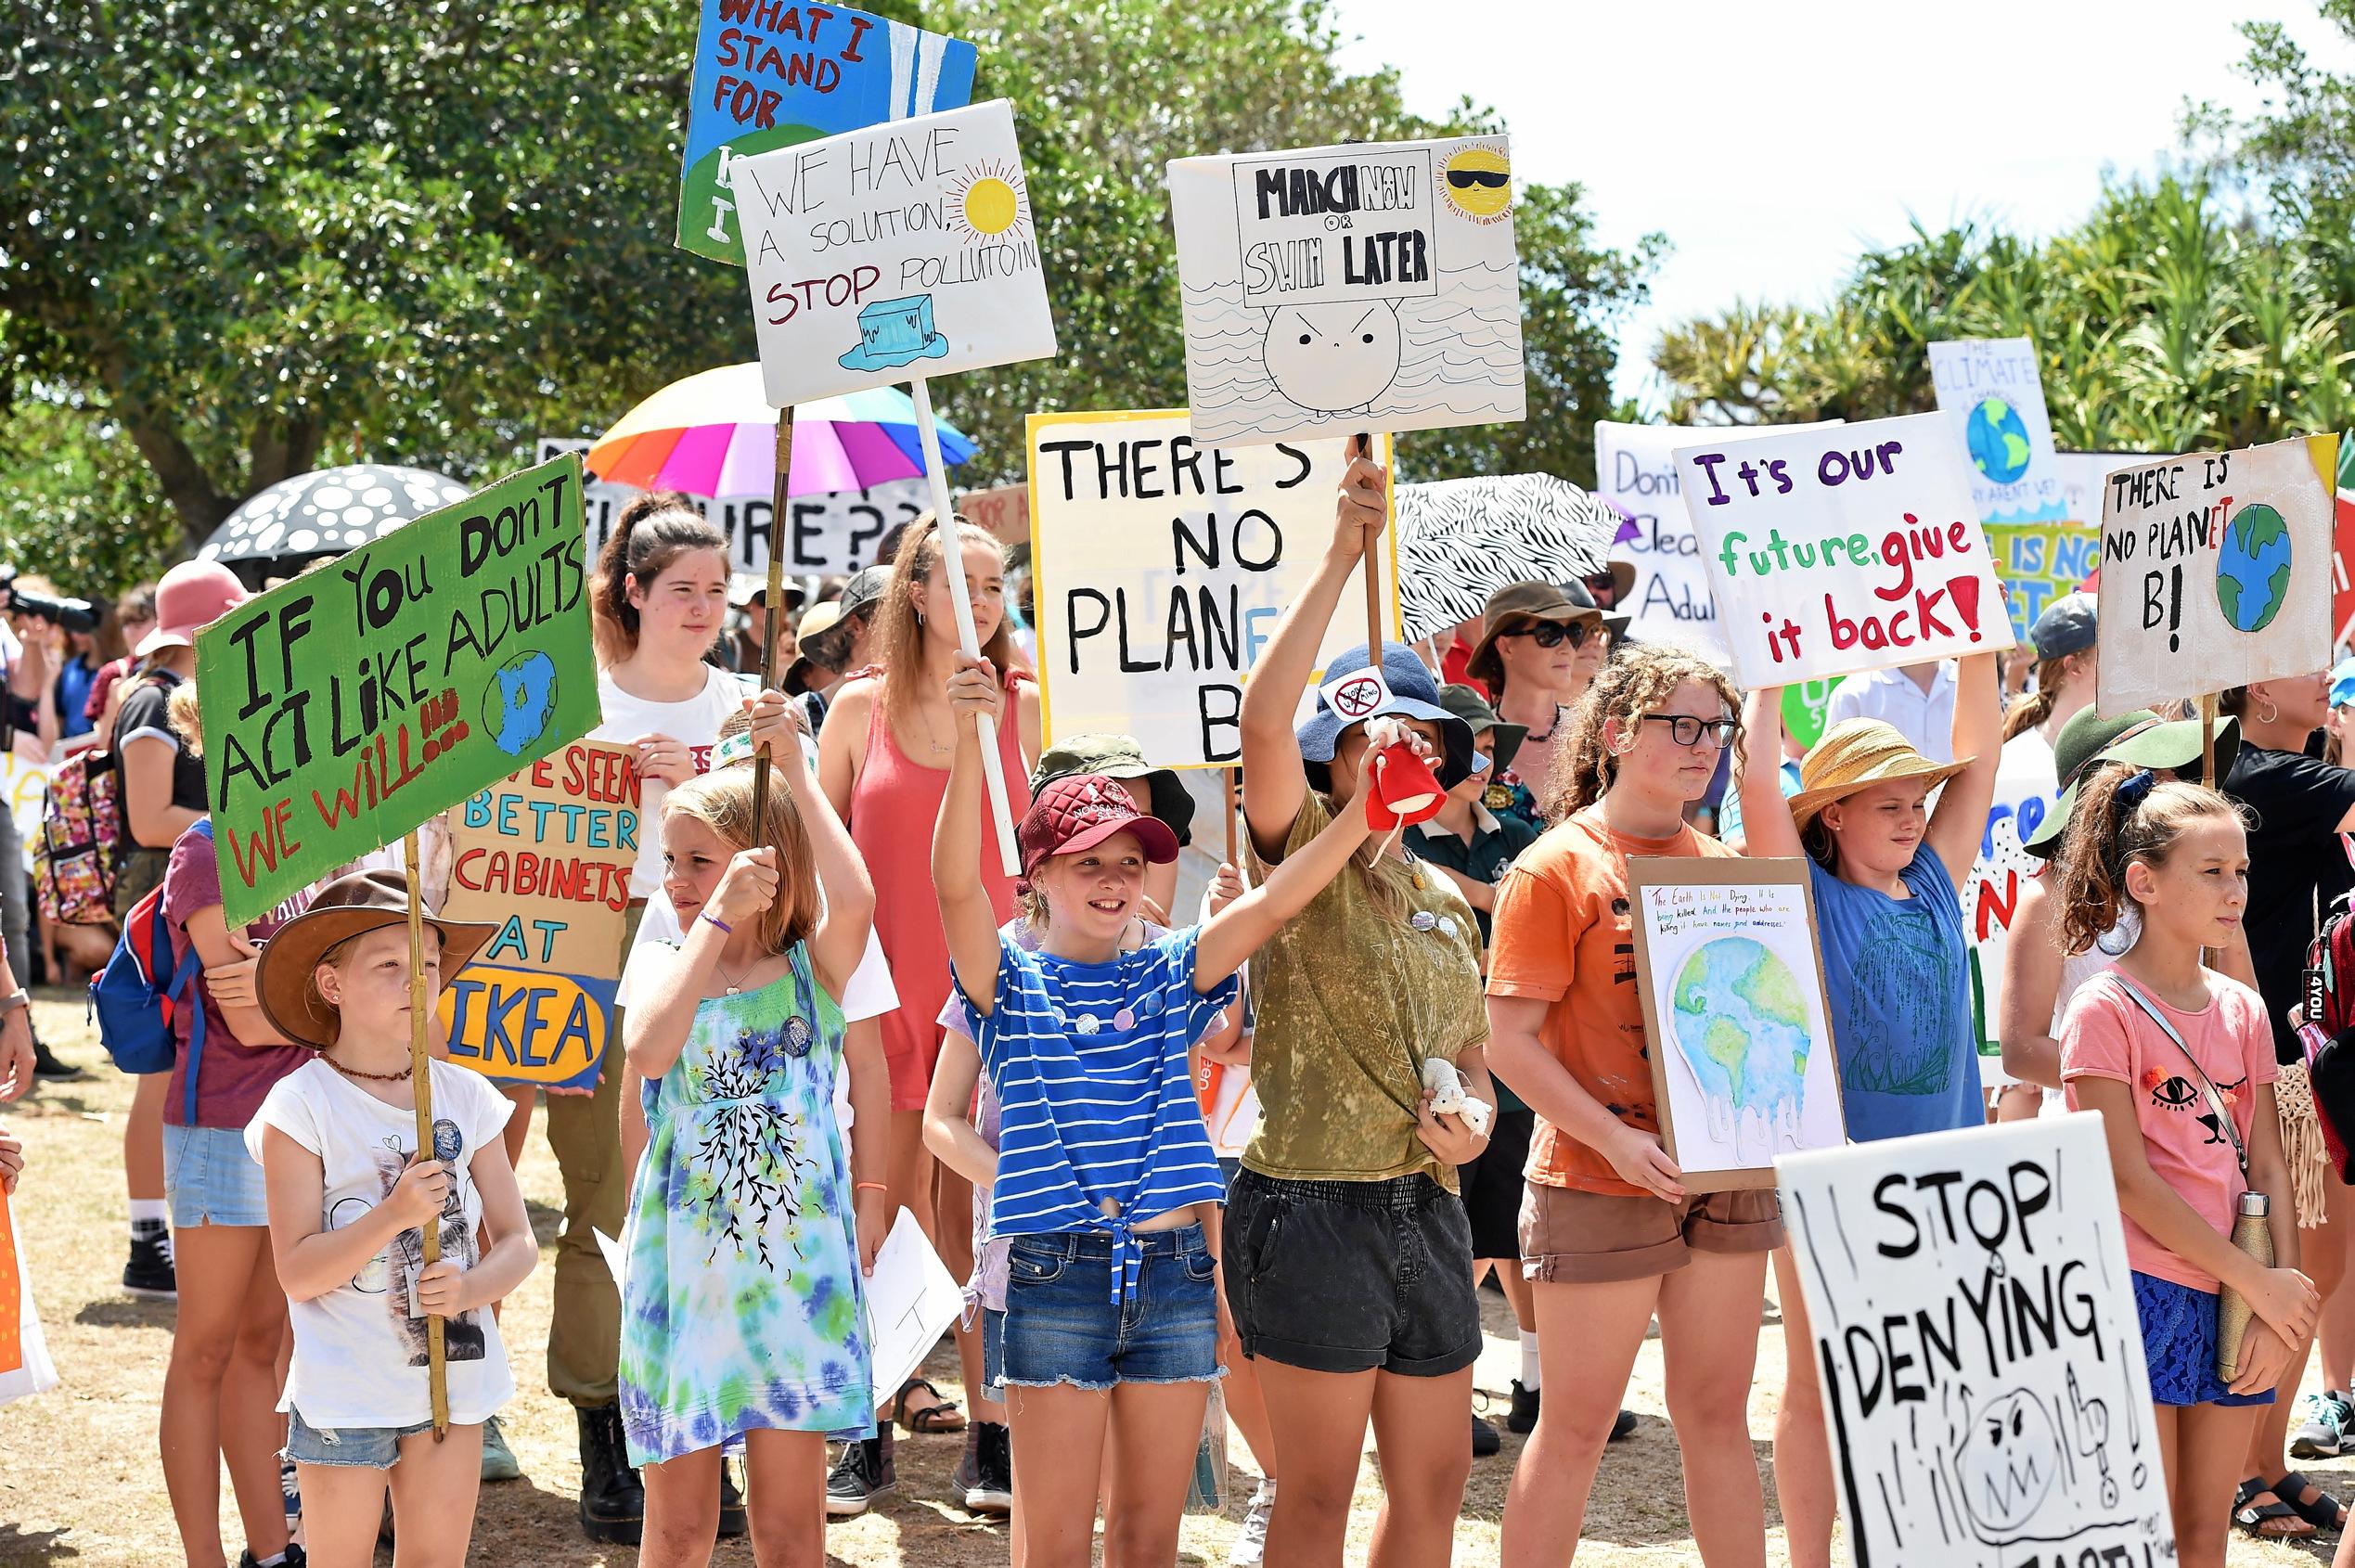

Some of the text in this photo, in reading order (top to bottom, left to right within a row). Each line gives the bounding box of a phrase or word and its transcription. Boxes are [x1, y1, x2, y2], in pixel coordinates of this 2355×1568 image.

[715, 28, 841, 94] STAND
[718, 0, 874, 62] WHAT I
[714, 74, 783, 131] FOR
[751, 128, 959, 218] WE HAVE
[1255, 164, 1416, 220] MARCH NOW
[758, 197, 951, 265] A SOLUTION,
[1324, 214, 1353, 231] OR
[1245, 230, 1429, 295] SWIM LATER
[766, 264, 881, 326] STOP
[1934, 355, 2038, 392] CLIMATE
[1692, 452, 1794, 507] It's
[2111, 454, 2231, 513] THERE IS
[1172, 509, 1283, 575] NO
[1626, 513, 1701, 557] Clea
[2011, 535, 2045, 573] IS
[2051, 533, 2101, 580] NO
[2104, 496, 2234, 566] NO PLANET
[1641, 572, 1716, 622] Adul
[2143, 564, 2183, 653] B!
[229, 595, 314, 722] IF
[1067, 584, 1280, 675] PLANE
[1761, 611, 1802, 663] it
[218, 690, 312, 813] ACT
[444, 533, 583, 677] ADULTS
[1198, 684, 1242, 762] B
[561, 745, 641, 809] SEEN
[227, 797, 302, 889] WE
[464, 791, 639, 851] BETTER
[456, 848, 633, 912] CABINETS
[1672, 887, 1693, 906] Earth
[1735, 906, 1757, 917] people
[1759, 904, 1772, 914] who
[486, 915, 567, 963] AT
[446, 980, 593, 1067] IKEA
[2310, 976, 2323, 1020] 4YOU
[1872, 1161, 2051, 1259] STOP
